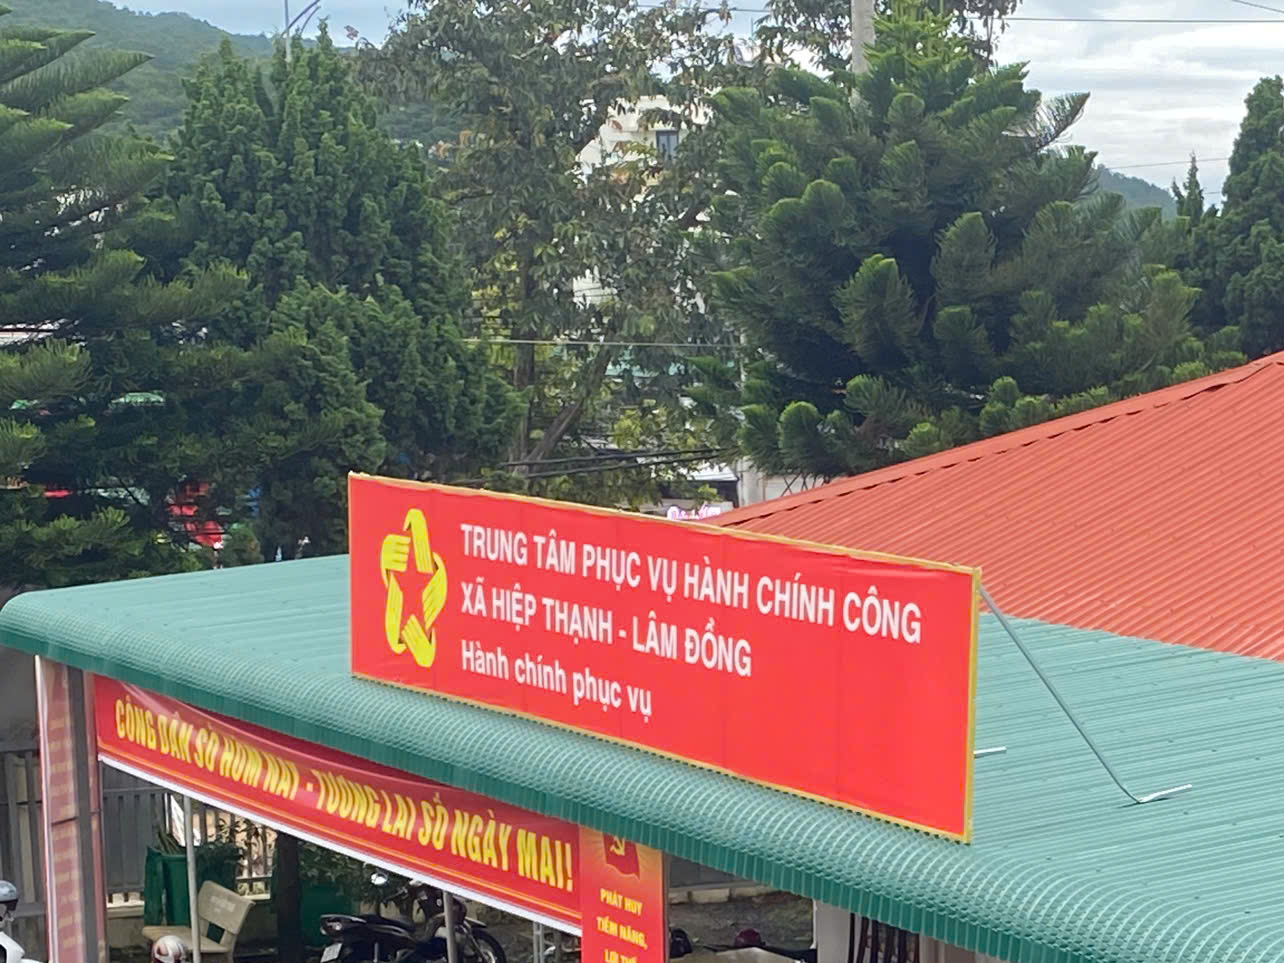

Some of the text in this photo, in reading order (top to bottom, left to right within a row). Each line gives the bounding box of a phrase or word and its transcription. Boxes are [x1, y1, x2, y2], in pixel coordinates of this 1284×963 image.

[460, 523, 921, 644] TRUNG TÂM PHỤC VỤ HÀNH CHÍNH CÔNG
[461, 576, 752, 677] XÃ HIỆP THẠNH - LÂM ĐỒNG
[461, 639, 652, 723] Hành chính phục vụ
[115, 695, 157, 751] CÔNG
[157, 711, 194, 764] DÂN
[380, 789, 417, 841] LAI
[451, 809, 513, 872] NGÀY
[516, 828, 573, 893] MAI!
[600, 888, 643, 916] PHÁT HUY
